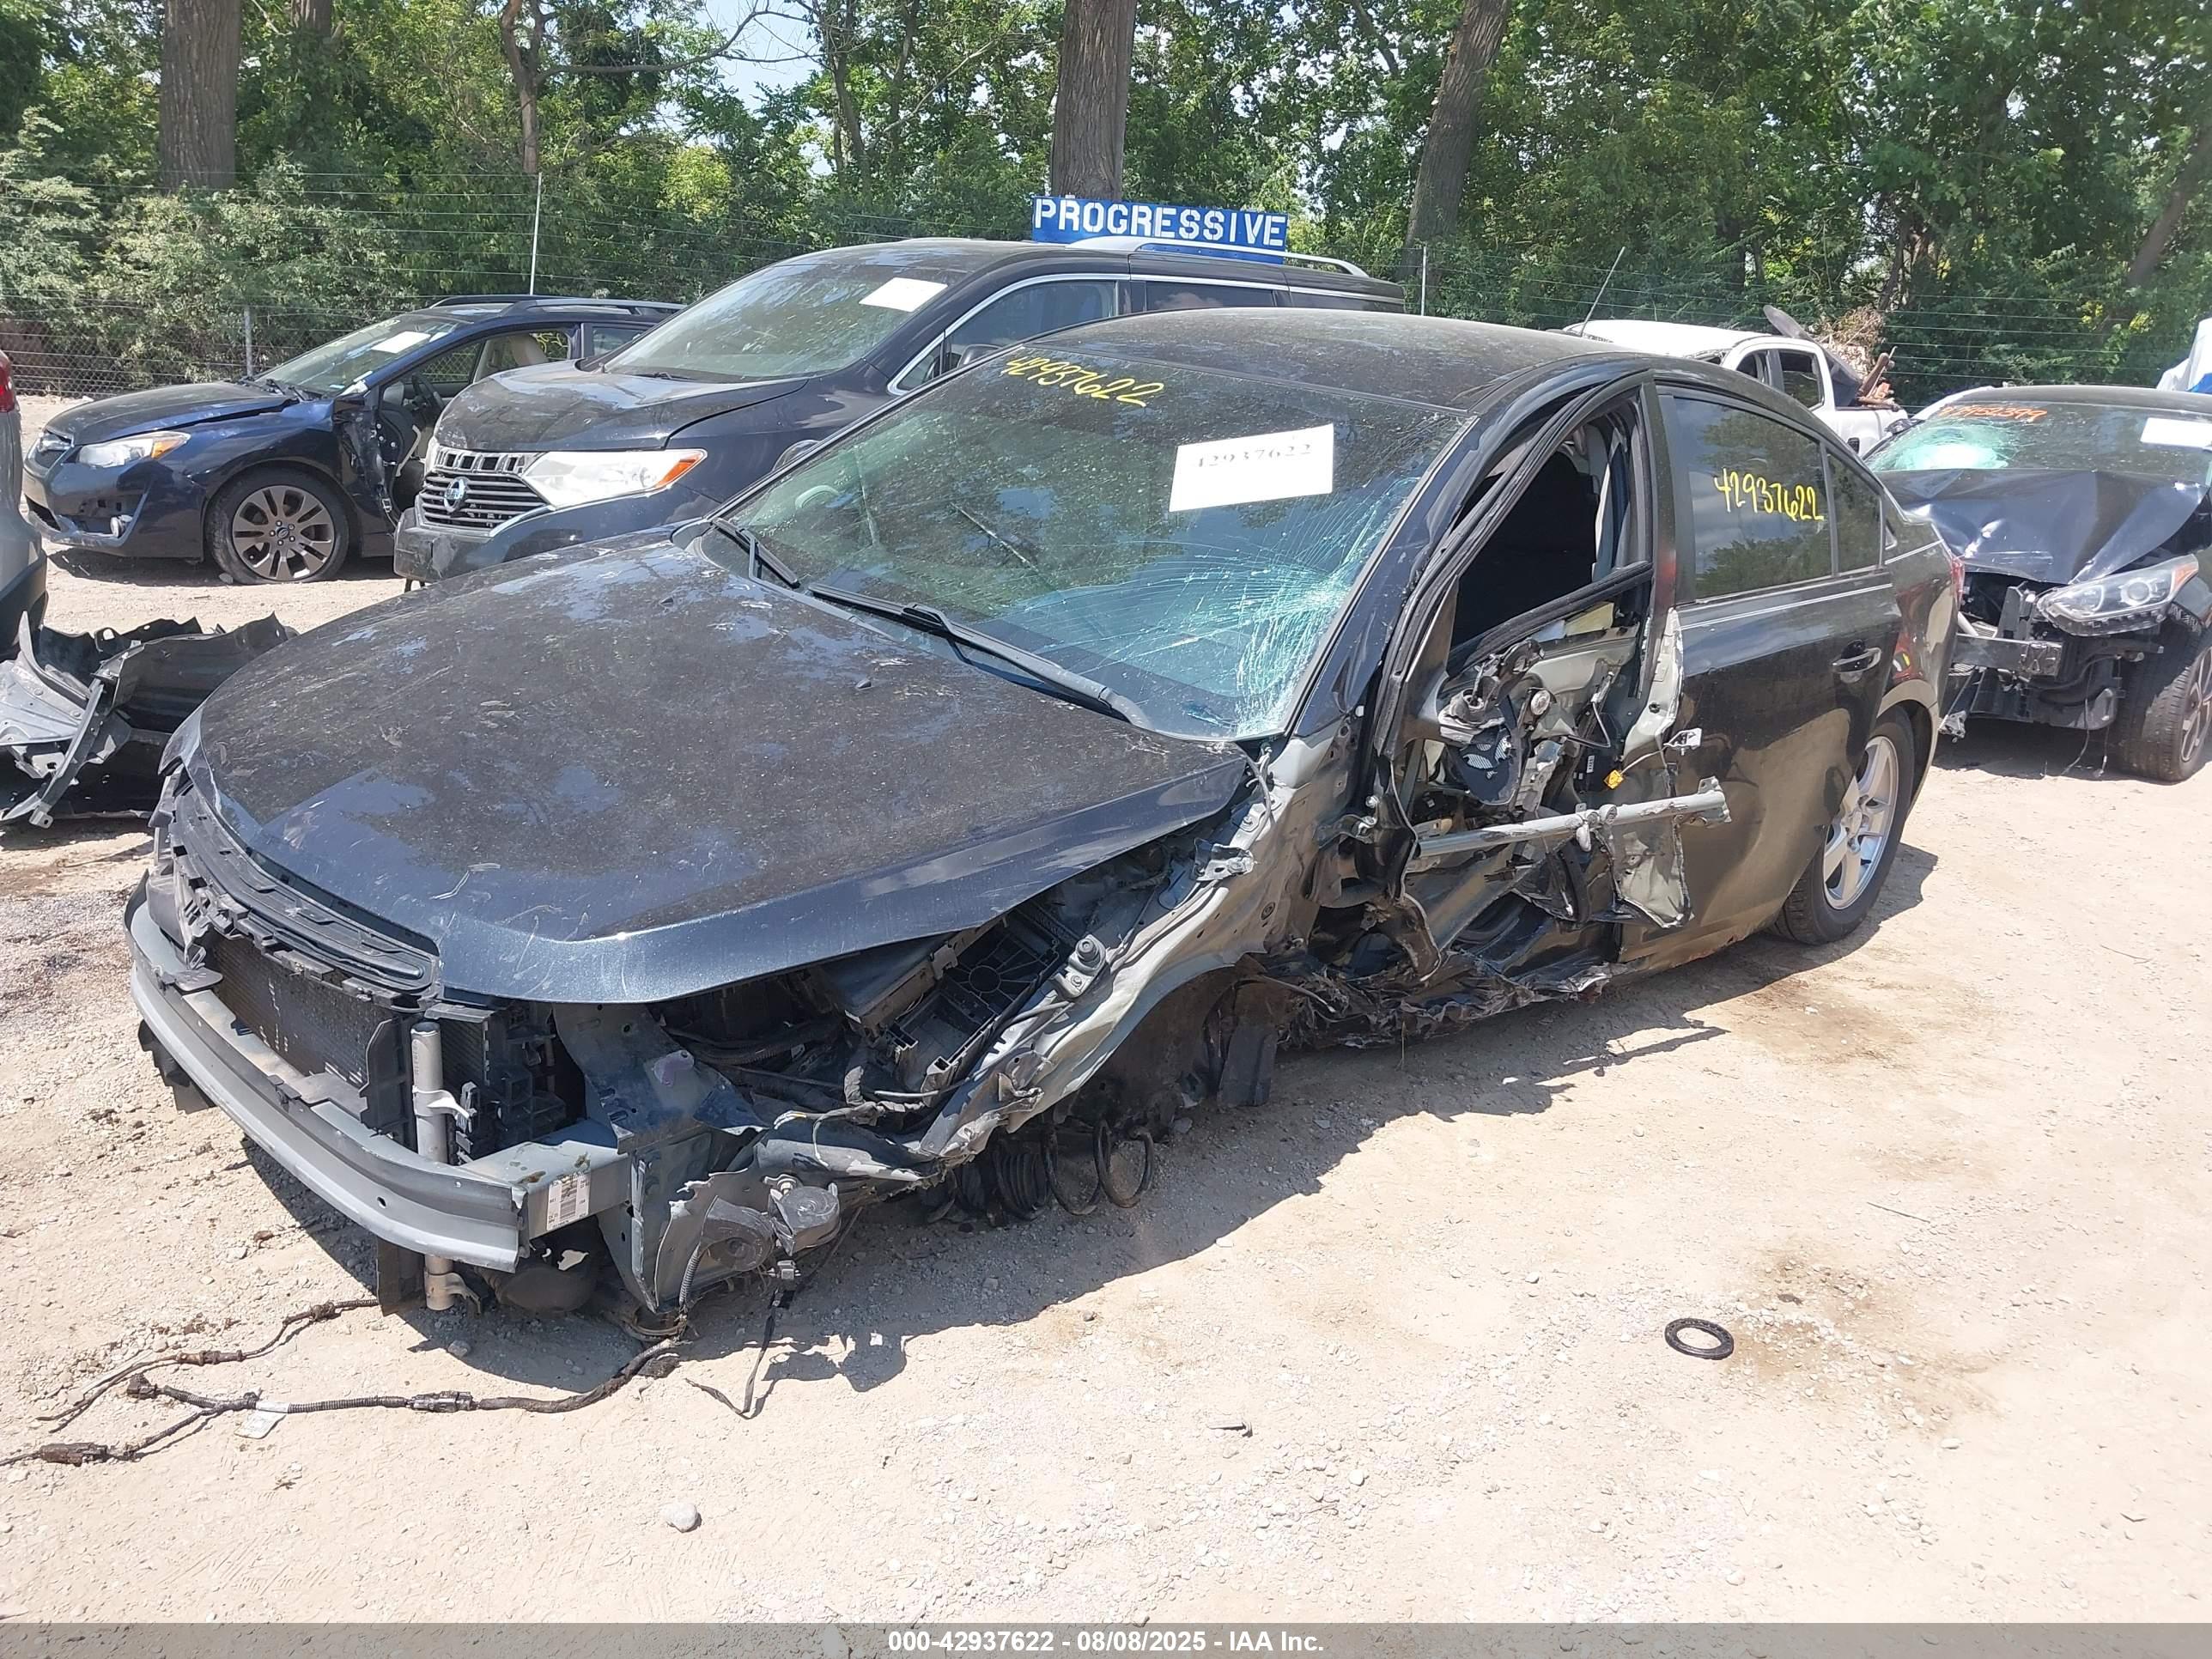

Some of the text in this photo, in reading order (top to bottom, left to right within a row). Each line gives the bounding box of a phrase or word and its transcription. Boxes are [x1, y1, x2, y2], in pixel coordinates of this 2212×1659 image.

[1034, 198, 1287, 246] PROGRESSIVE
[1000, 356, 1164, 408] 42937622
[1714, 467, 1824, 521] 42937622
